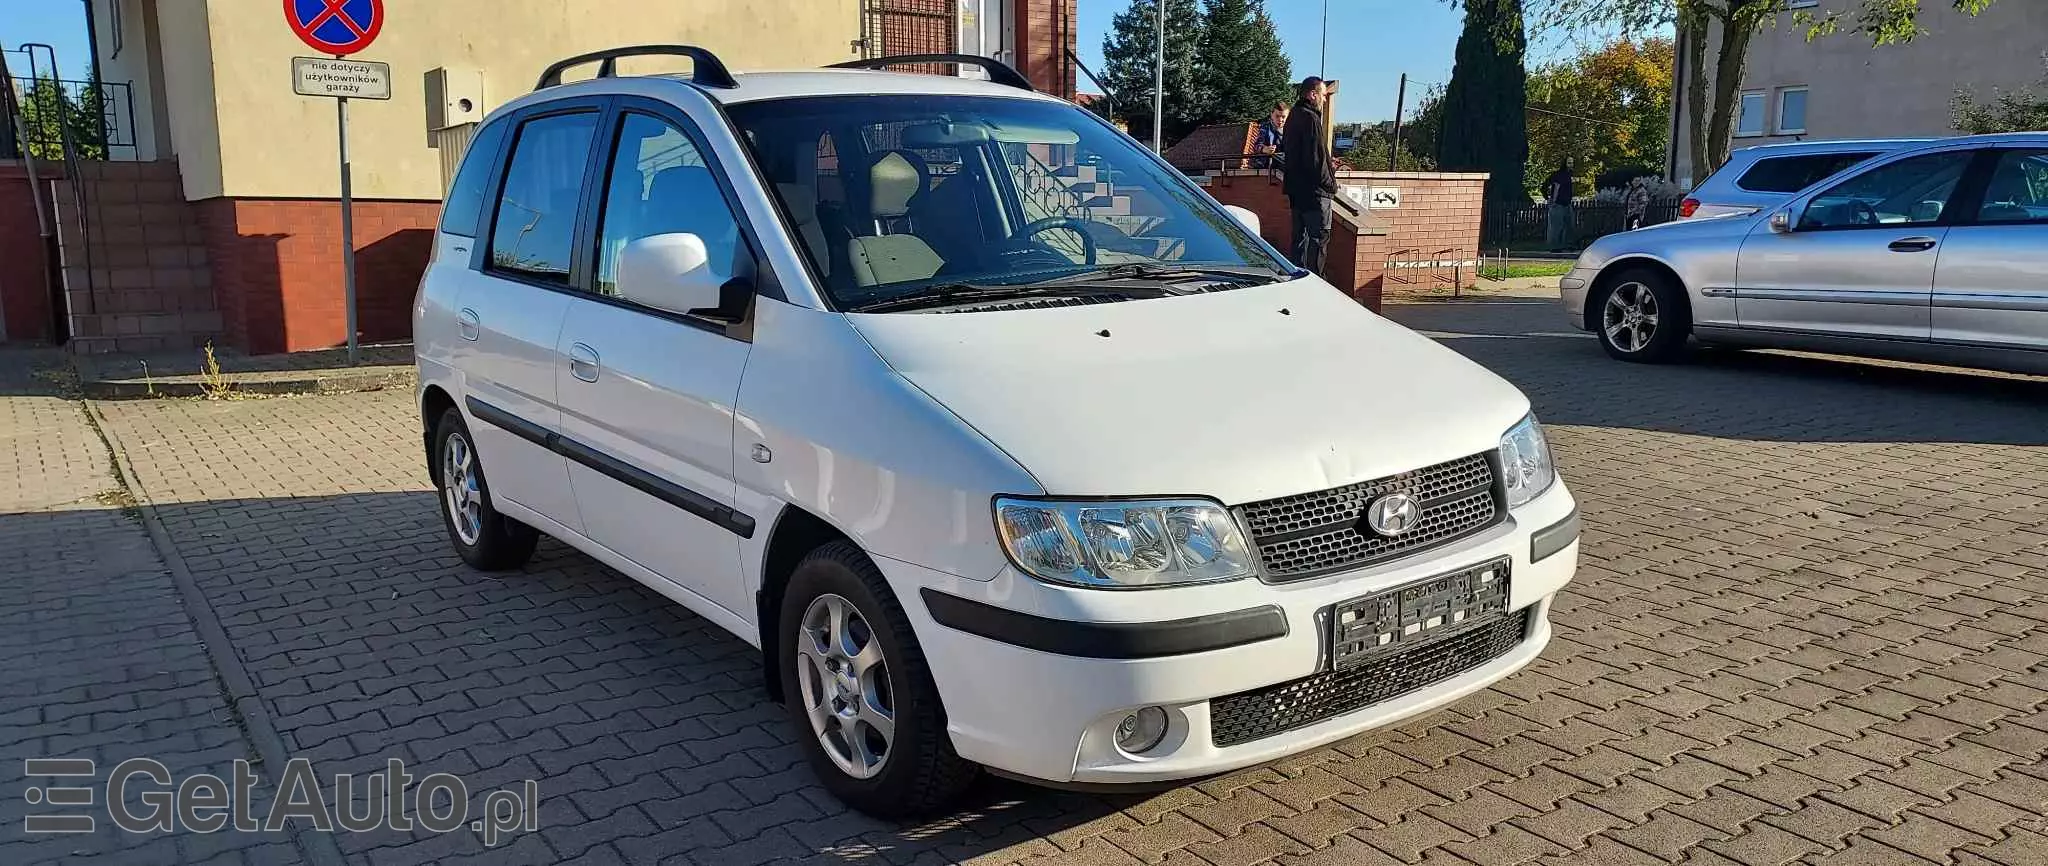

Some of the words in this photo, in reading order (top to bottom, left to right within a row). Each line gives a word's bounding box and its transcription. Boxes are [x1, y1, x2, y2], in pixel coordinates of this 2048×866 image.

[312, 62, 328, 70] nie
[330, 62, 371, 74] dotyczy
[305, 73, 379, 84] użytkowników
[326, 83, 360, 93] garaży
